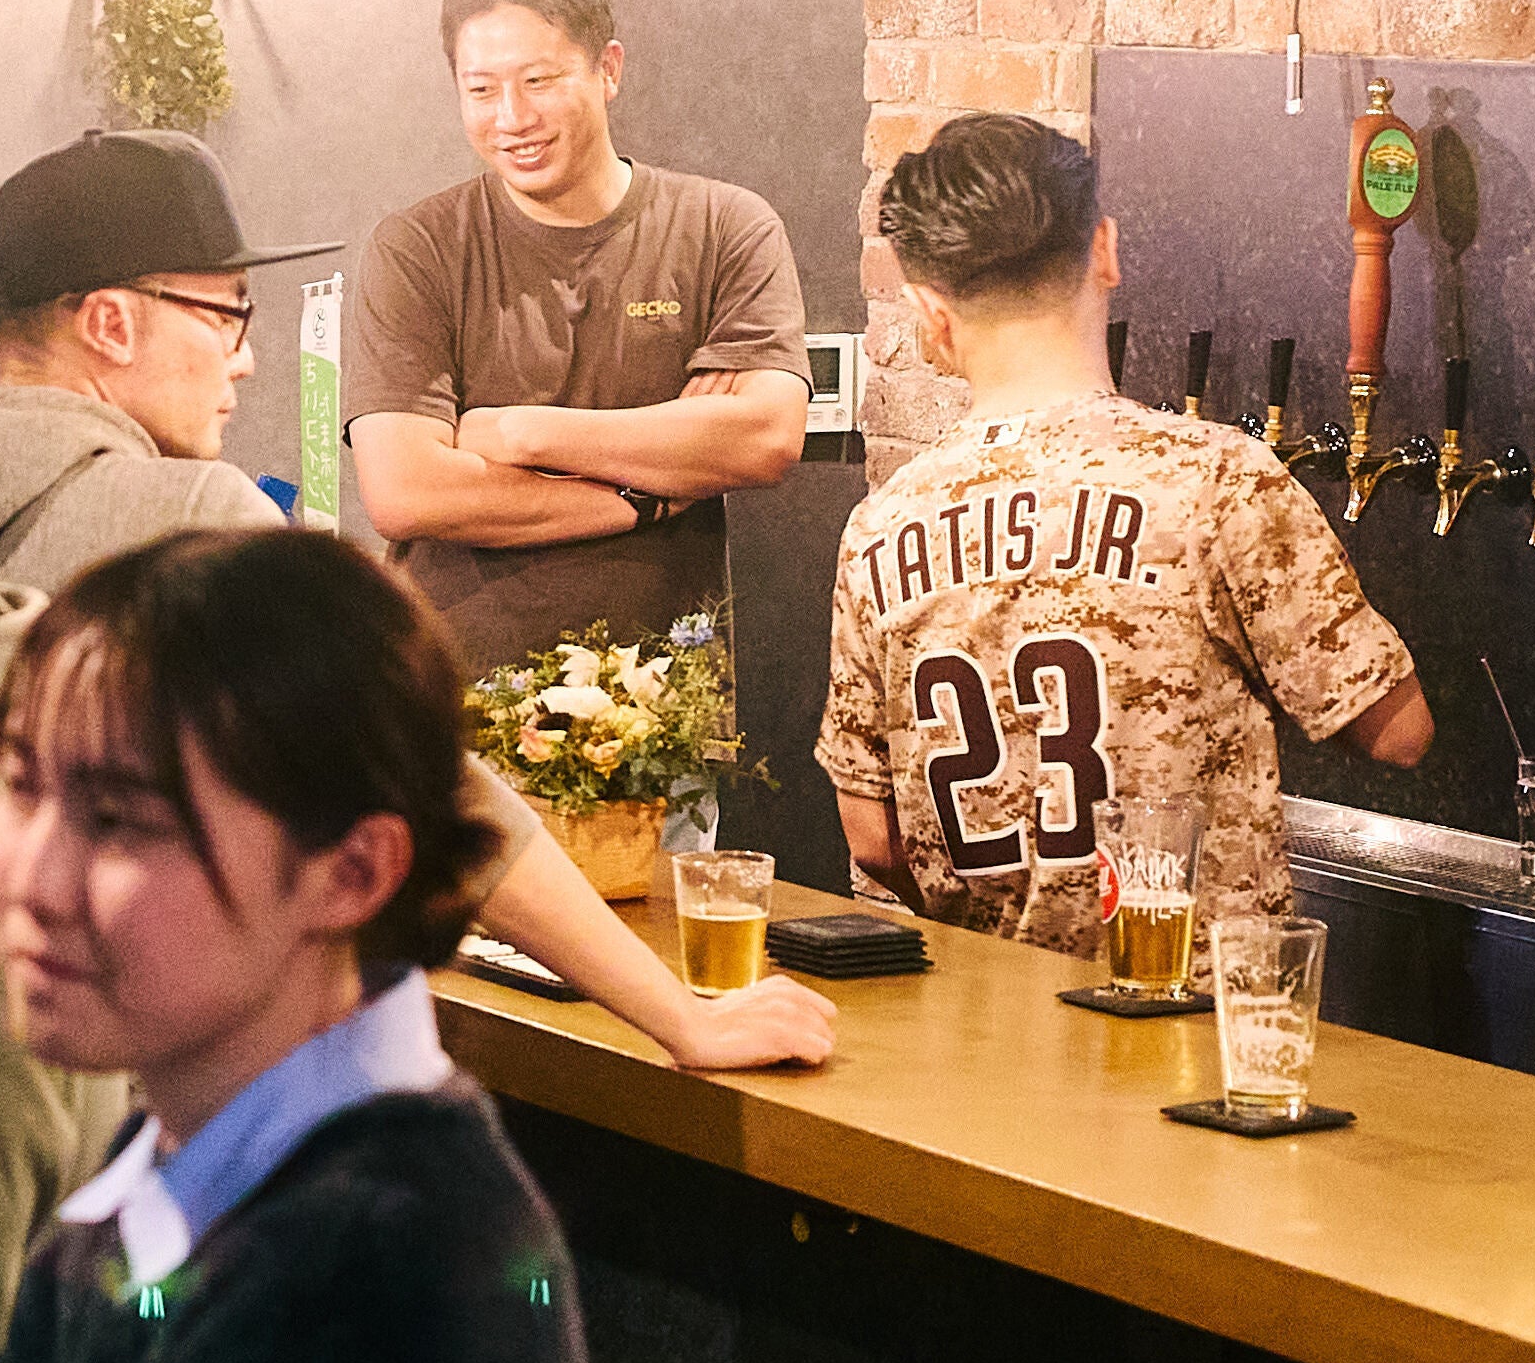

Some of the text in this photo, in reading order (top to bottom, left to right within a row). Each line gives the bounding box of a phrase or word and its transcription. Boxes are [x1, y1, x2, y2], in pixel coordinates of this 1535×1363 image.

[1366, 180, 1413, 193] PALE ALE
[626, 300, 681, 317] GECKO
[861, 484, 1163, 620] TATIS JR.
[909, 632, 1116, 876] 23
